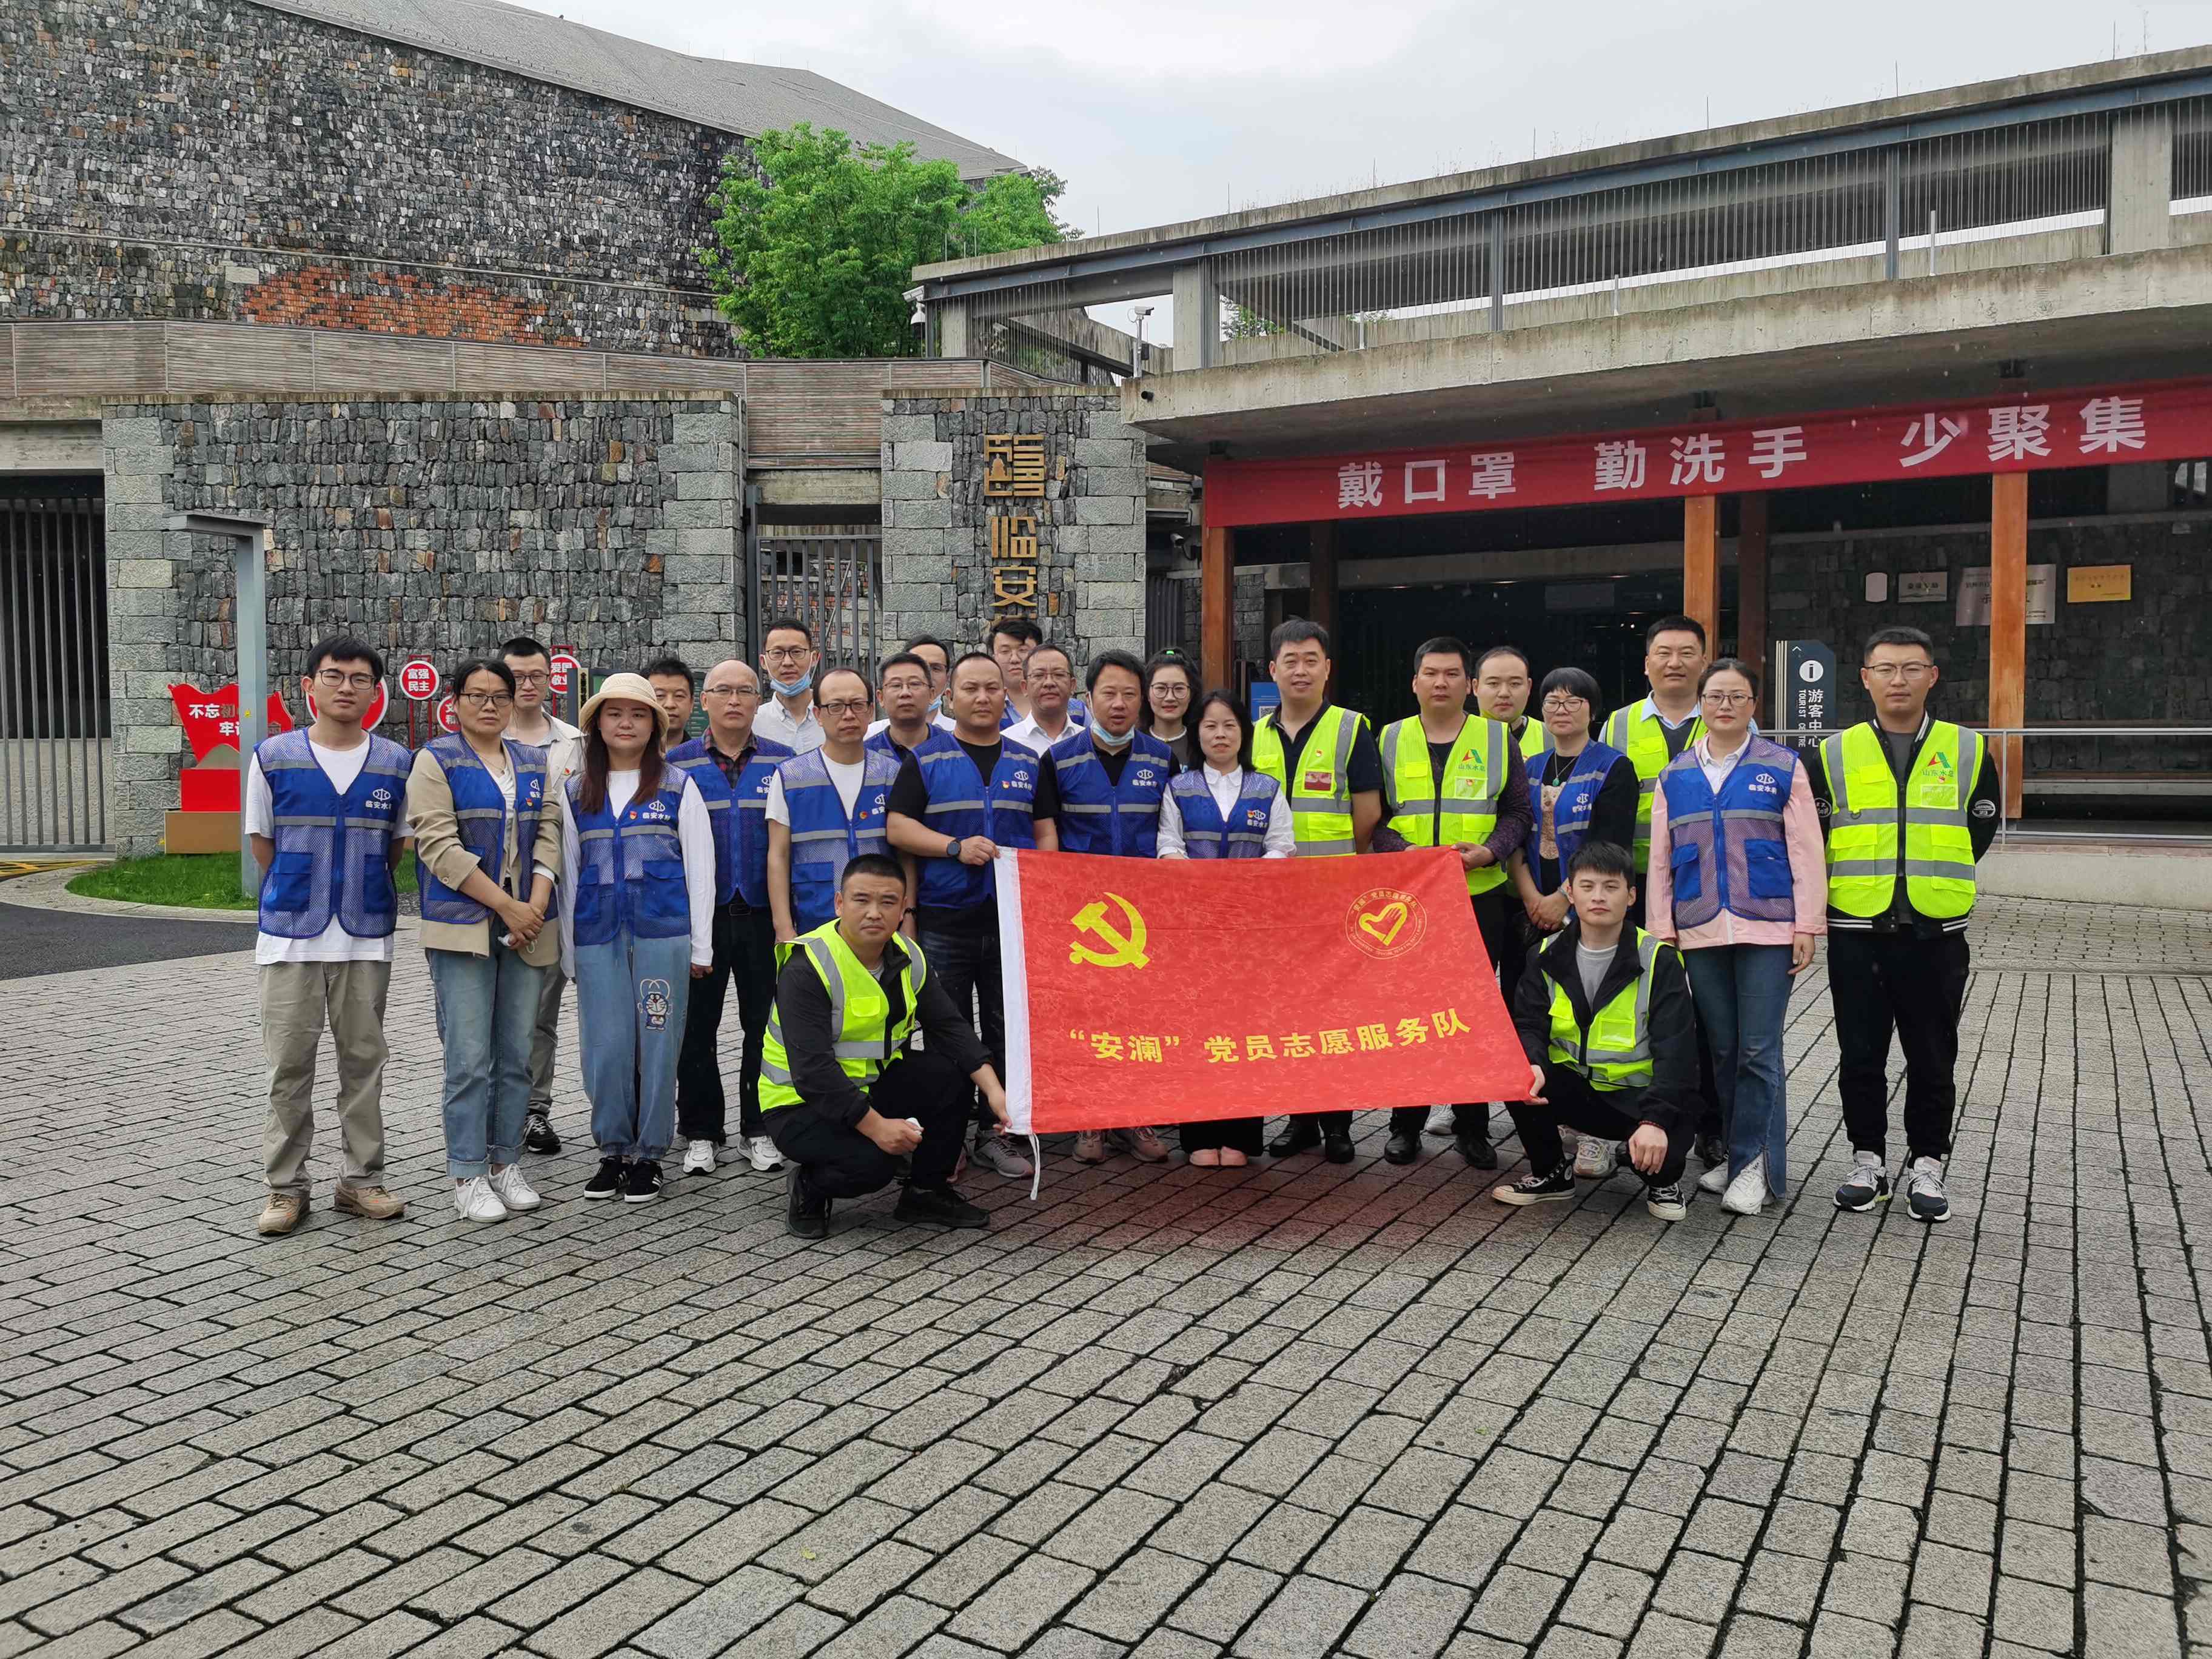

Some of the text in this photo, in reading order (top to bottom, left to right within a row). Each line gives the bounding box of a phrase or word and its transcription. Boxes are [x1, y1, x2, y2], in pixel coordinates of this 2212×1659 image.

[1338, 396, 2147, 509] 戴口罩 勤洗手 少聚集
[990, 516, 1038, 618] 临安
[407, 669, 430, 679] 富强
[408, 681, 430, 691] 民主
[445, 703, 457, 712] 文
[1808, 689, 1824, 748] 游客中心
[1204, 1008, 1471, 1063] 党员志愿服务队
